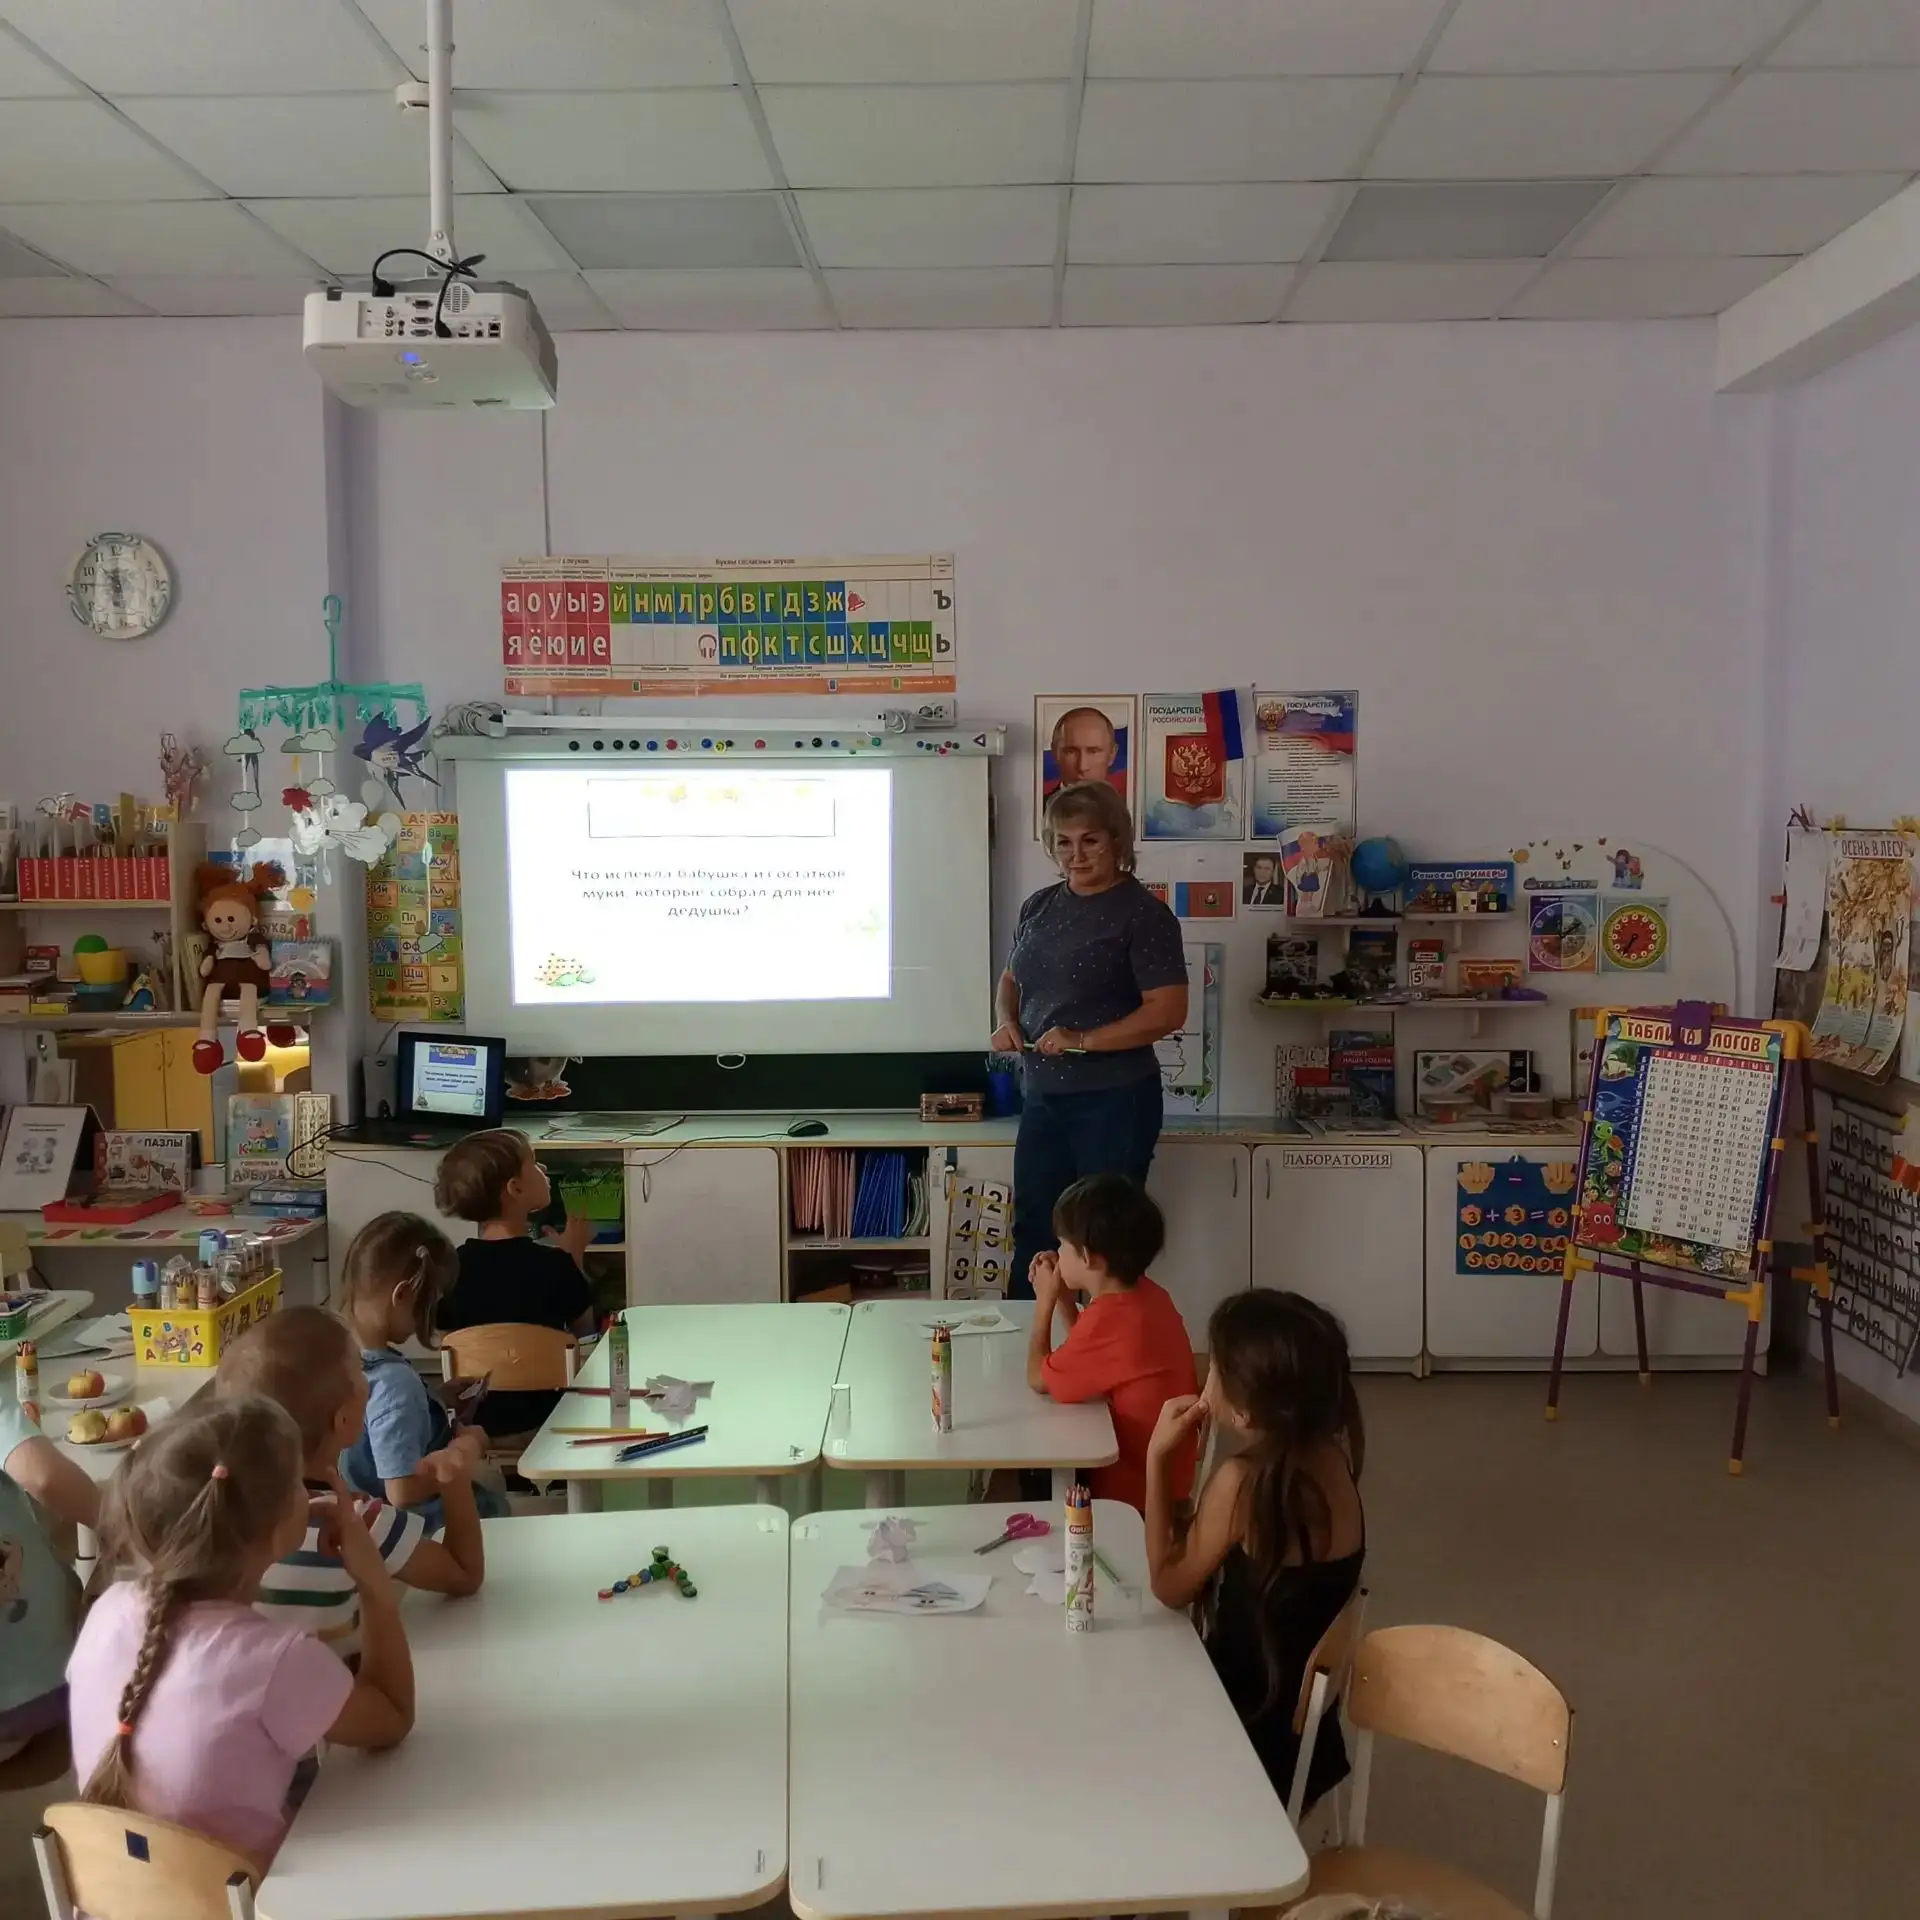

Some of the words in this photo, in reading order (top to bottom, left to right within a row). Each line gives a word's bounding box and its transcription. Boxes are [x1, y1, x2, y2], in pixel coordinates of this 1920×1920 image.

[507, 593, 520, 613] а
[527, 593, 541, 613] о
[548, 594, 562, 619] у
[566, 593, 587, 613] ы
[592, 593, 606, 613] э
[613, 585, 628, 612] й
[636, 593, 649, 612] н
[655, 592, 674, 612] м
[678, 592, 694, 612] л
[700, 592, 714, 619] р
[719, 586, 735, 613] б
[741, 593, 756, 612] в
[765, 592, 775, 611] г
[783, 593, 800, 616] д
[807, 592, 820, 611] з
[826, 592, 845, 611] ж
[507, 636, 522, 655] я
[529, 628, 542, 655] ё
[548, 636, 565, 655] ю
[570, 636, 585, 655] и
[593, 636, 607, 655] е
[722, 638, 736, 657] п
[741, 630, 759, 663] ф
[765, 637, 779, 655] к
[786, 637, 800, 655] т
[810, 636, 821, 654] с
[827, 636, 845, 654] ш
[850, 635, 864, 653] х
[870, 635, 887, 658] ц
[894, 635, 907, 653] ч
[910, 635, 932, 658] щ
[408, 814, 458, 824] АЗБУК
[1842, 840, 1870, 856] ОСЕНЬ
[1872, 840, 1879, 856] В
[1881, 840, 1904, 858] ЛЕСУ
[571, 868, 600, 881] Что
[1412, 871, 1454, 879] Решаем
[1456, 869, 1507, 879] ПРИМЕРЫ
[1414, 972, 1422, 983] 5
[1627, 1021, 1697, 1045] ТАБЛИА
[144, 1138, 184, 1147] ПАЗЛЫ
[1285, 1154, 1390, 1166] ЛАБОРАТОРИЯ
[962, 1186, 974, 1208] 1
[988, 1191, 1003, 1214] 2
[1467, 1211, 1478, 1224] 3
[1512, 1209, 1522, 1222] 3
[1555, 1211, 1565, 1223] 6
[955, 1220, 972, 1242] 4
[984, 1228, 1000, 1248] 5
[1463, 1236, 1472, 1248] 1
[1504, 1235, 1515, 1247] 2
[1524, 1236, 1533, 1247] 2
[1469, 1254, 1481, 1265] 5
[1488, 1256, 1499, 1267] 5
[1507, 1255, 1518, 1266] 7
[954, 1258, 970, 1281] 8
[983, 1259, 999, 1283] 9
[143, 1326, 152, 1338] Б
